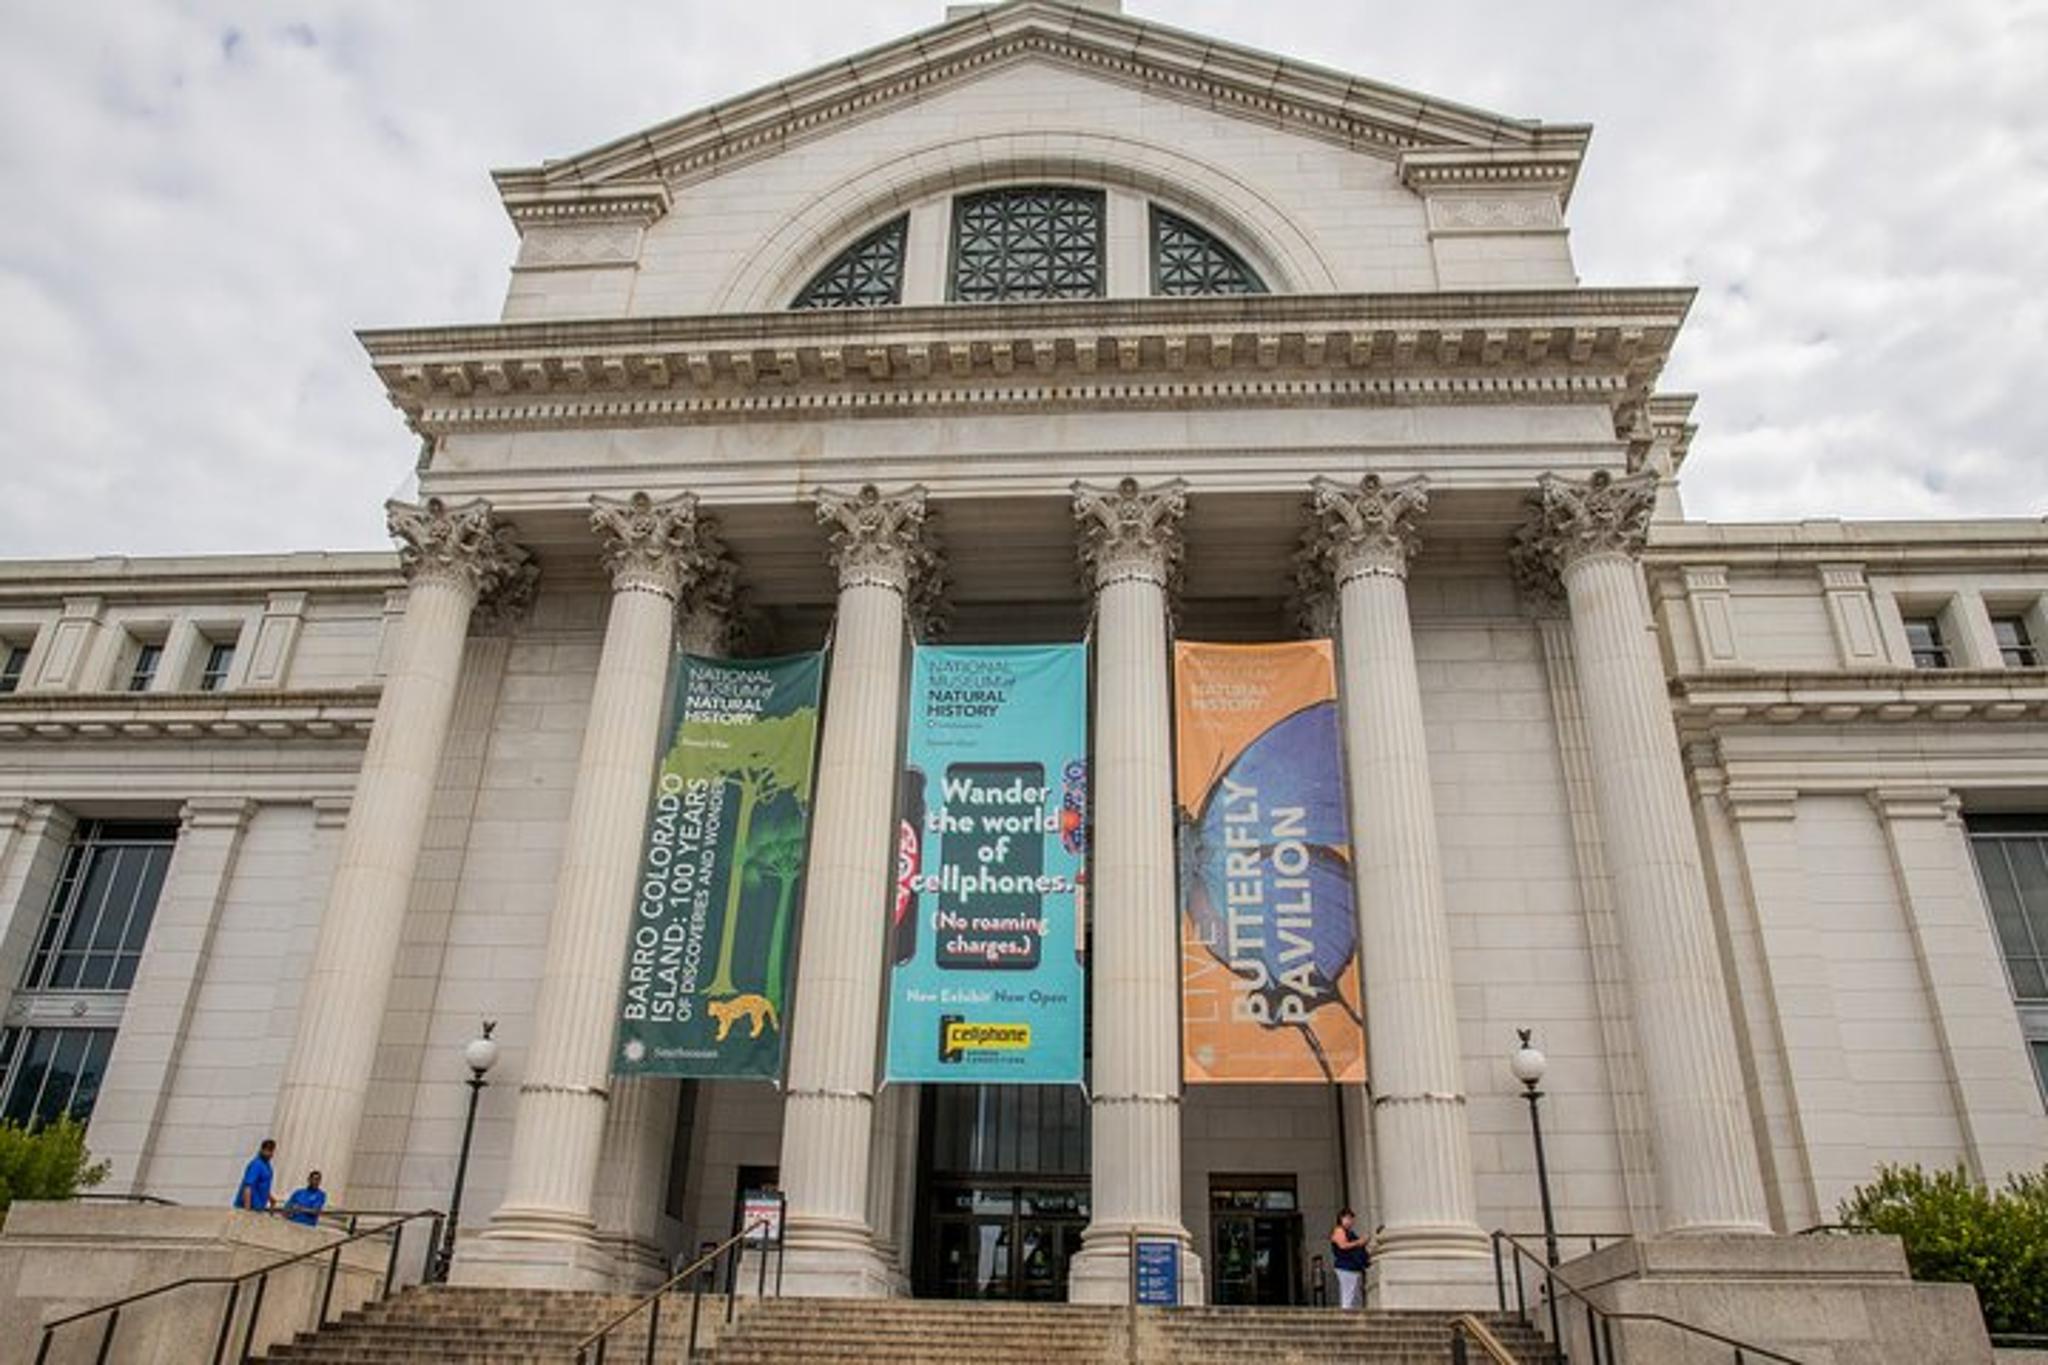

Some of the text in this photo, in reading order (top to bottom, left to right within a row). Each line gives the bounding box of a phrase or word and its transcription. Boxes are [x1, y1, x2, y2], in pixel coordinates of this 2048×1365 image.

[690, 667, 772, 683] NATIONAL
[686, 695, 763, 711] NATURAL
[928, 690, 1007, 702] NATURAL
[684, 710, 755, 726] HISTORY
[927, 705, 999, 717] HISTORY
[942, 778, 1051, 804] Wander
[677, 778, 709, 856] YEARS
[928, 806, 1060, 833] the world
[977, 836, 1011, 863] of
[699, 849, 715, 885] AND
[624, 773, 684, 1020] BARRO COLORADO
[670, 863, 696, 908] 100
[910, 865, 1076, 902] cellphones.
[1223, 776, 1274, 1023] BUTTERFLY
[931, 911, 1049, 936] (No roaming
[1271, 806, 1318, 1023] PAVILION
[681, 890, 709, 993] DISCOVERIES
[947, 935, 1031, 960] charges.)
[650, 917, 687, 1022] ISLAND:
[676, 998, 692, 1021] OF
[1029, 990, 1068, 1006] Open
